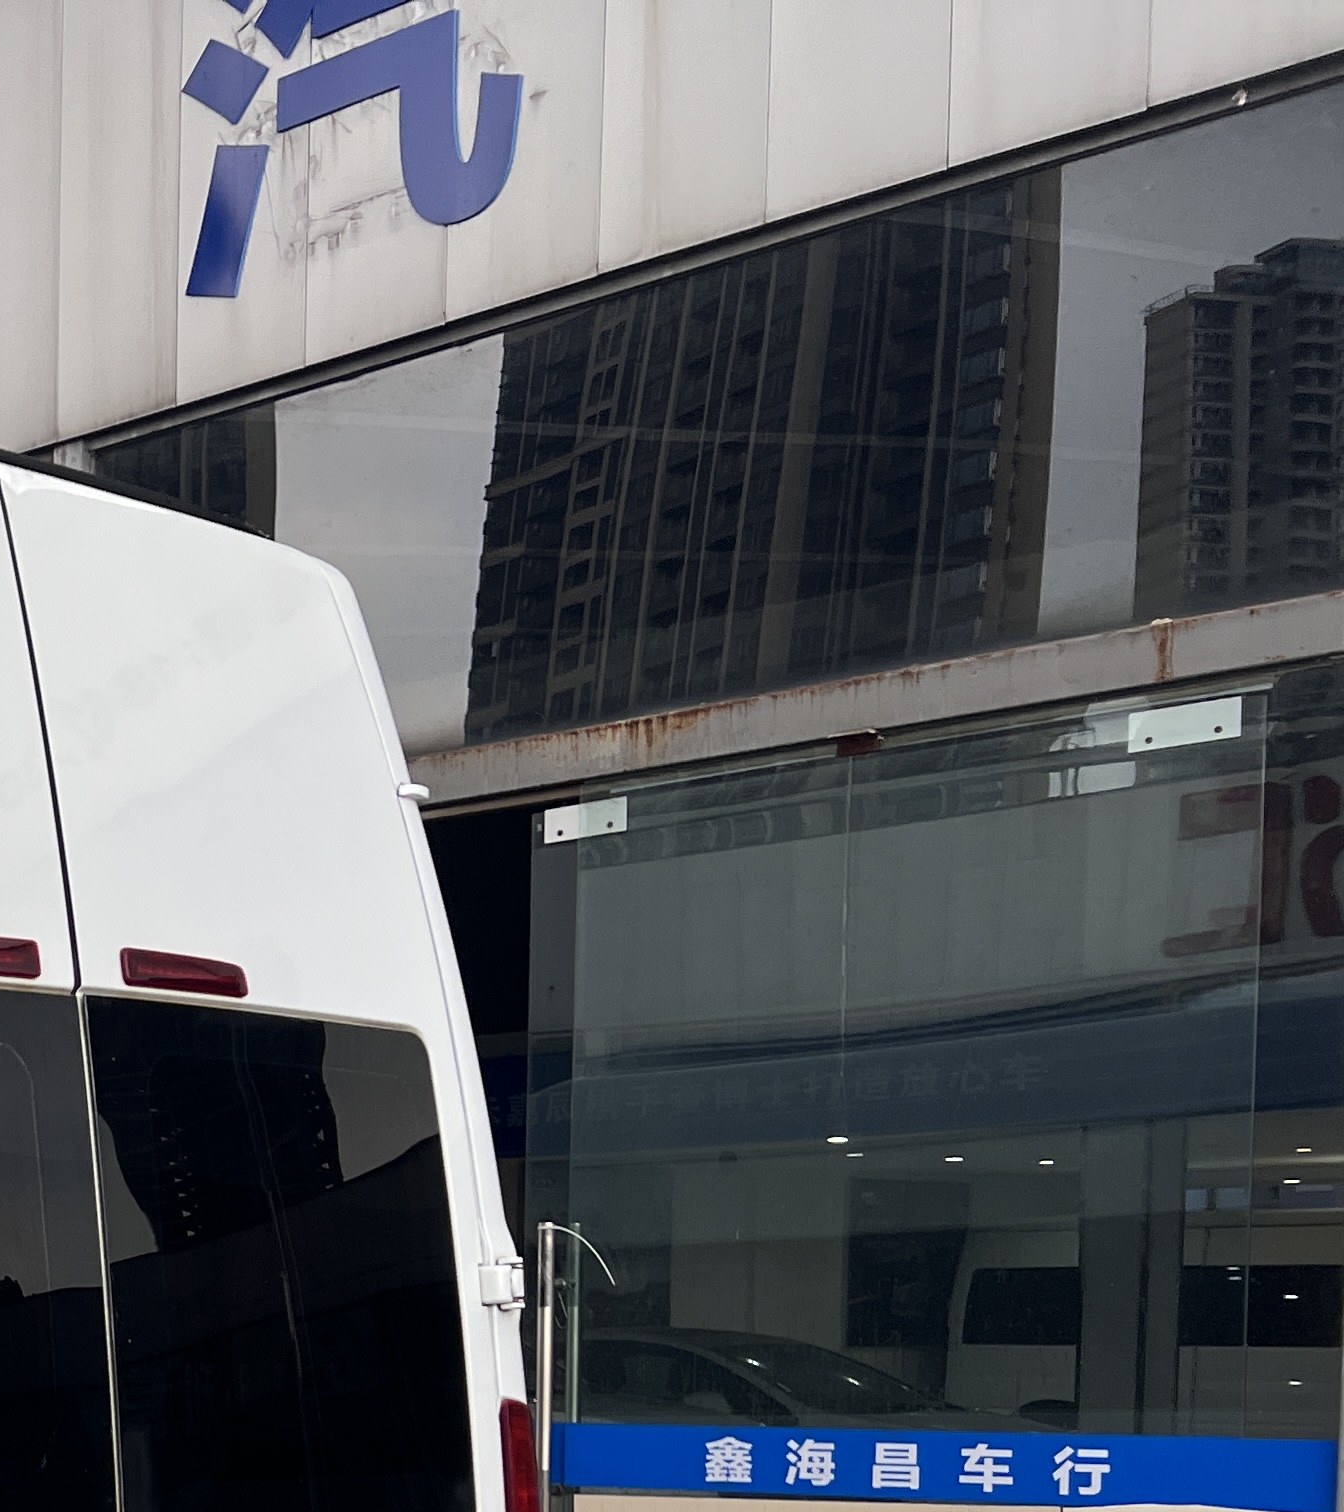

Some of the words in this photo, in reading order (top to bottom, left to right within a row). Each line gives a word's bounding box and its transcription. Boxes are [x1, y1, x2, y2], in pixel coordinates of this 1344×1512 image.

[704, 1435, 1111, 1496] 鑫海昌车行
